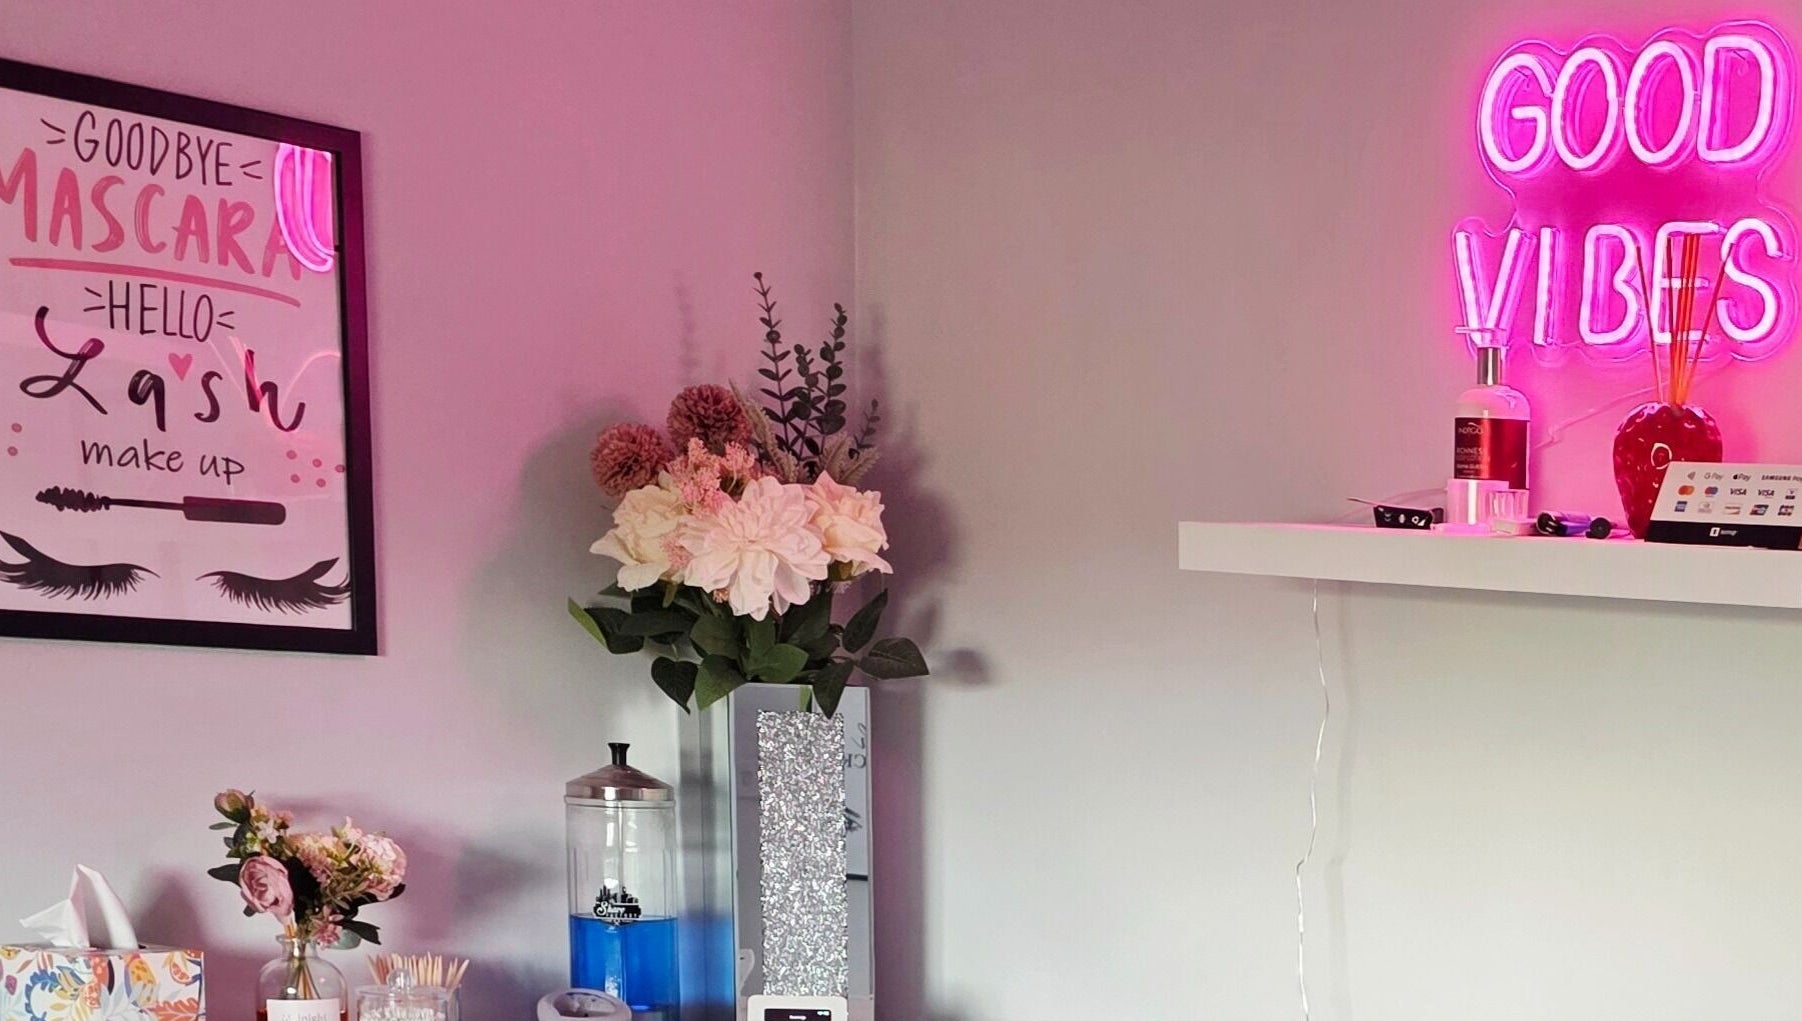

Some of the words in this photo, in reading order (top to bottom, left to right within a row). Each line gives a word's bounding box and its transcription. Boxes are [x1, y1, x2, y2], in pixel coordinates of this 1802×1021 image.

[1479, 34, 1776, 174] GOOD
[74, 110, 234, 187] GOODBYE
[0, 146, 303, 281] MASCARA
[108, 280, 214, 342] HELLO
[1454, 216, 1780, 350] VIBES
[19, 306, 306, 432] Lash
[81, 438, 184, 473] make
[200, 456, 245, 492] up
[1730, 488, 1747, 496] VISA
[1757, 489, 1775, 497] VISA
